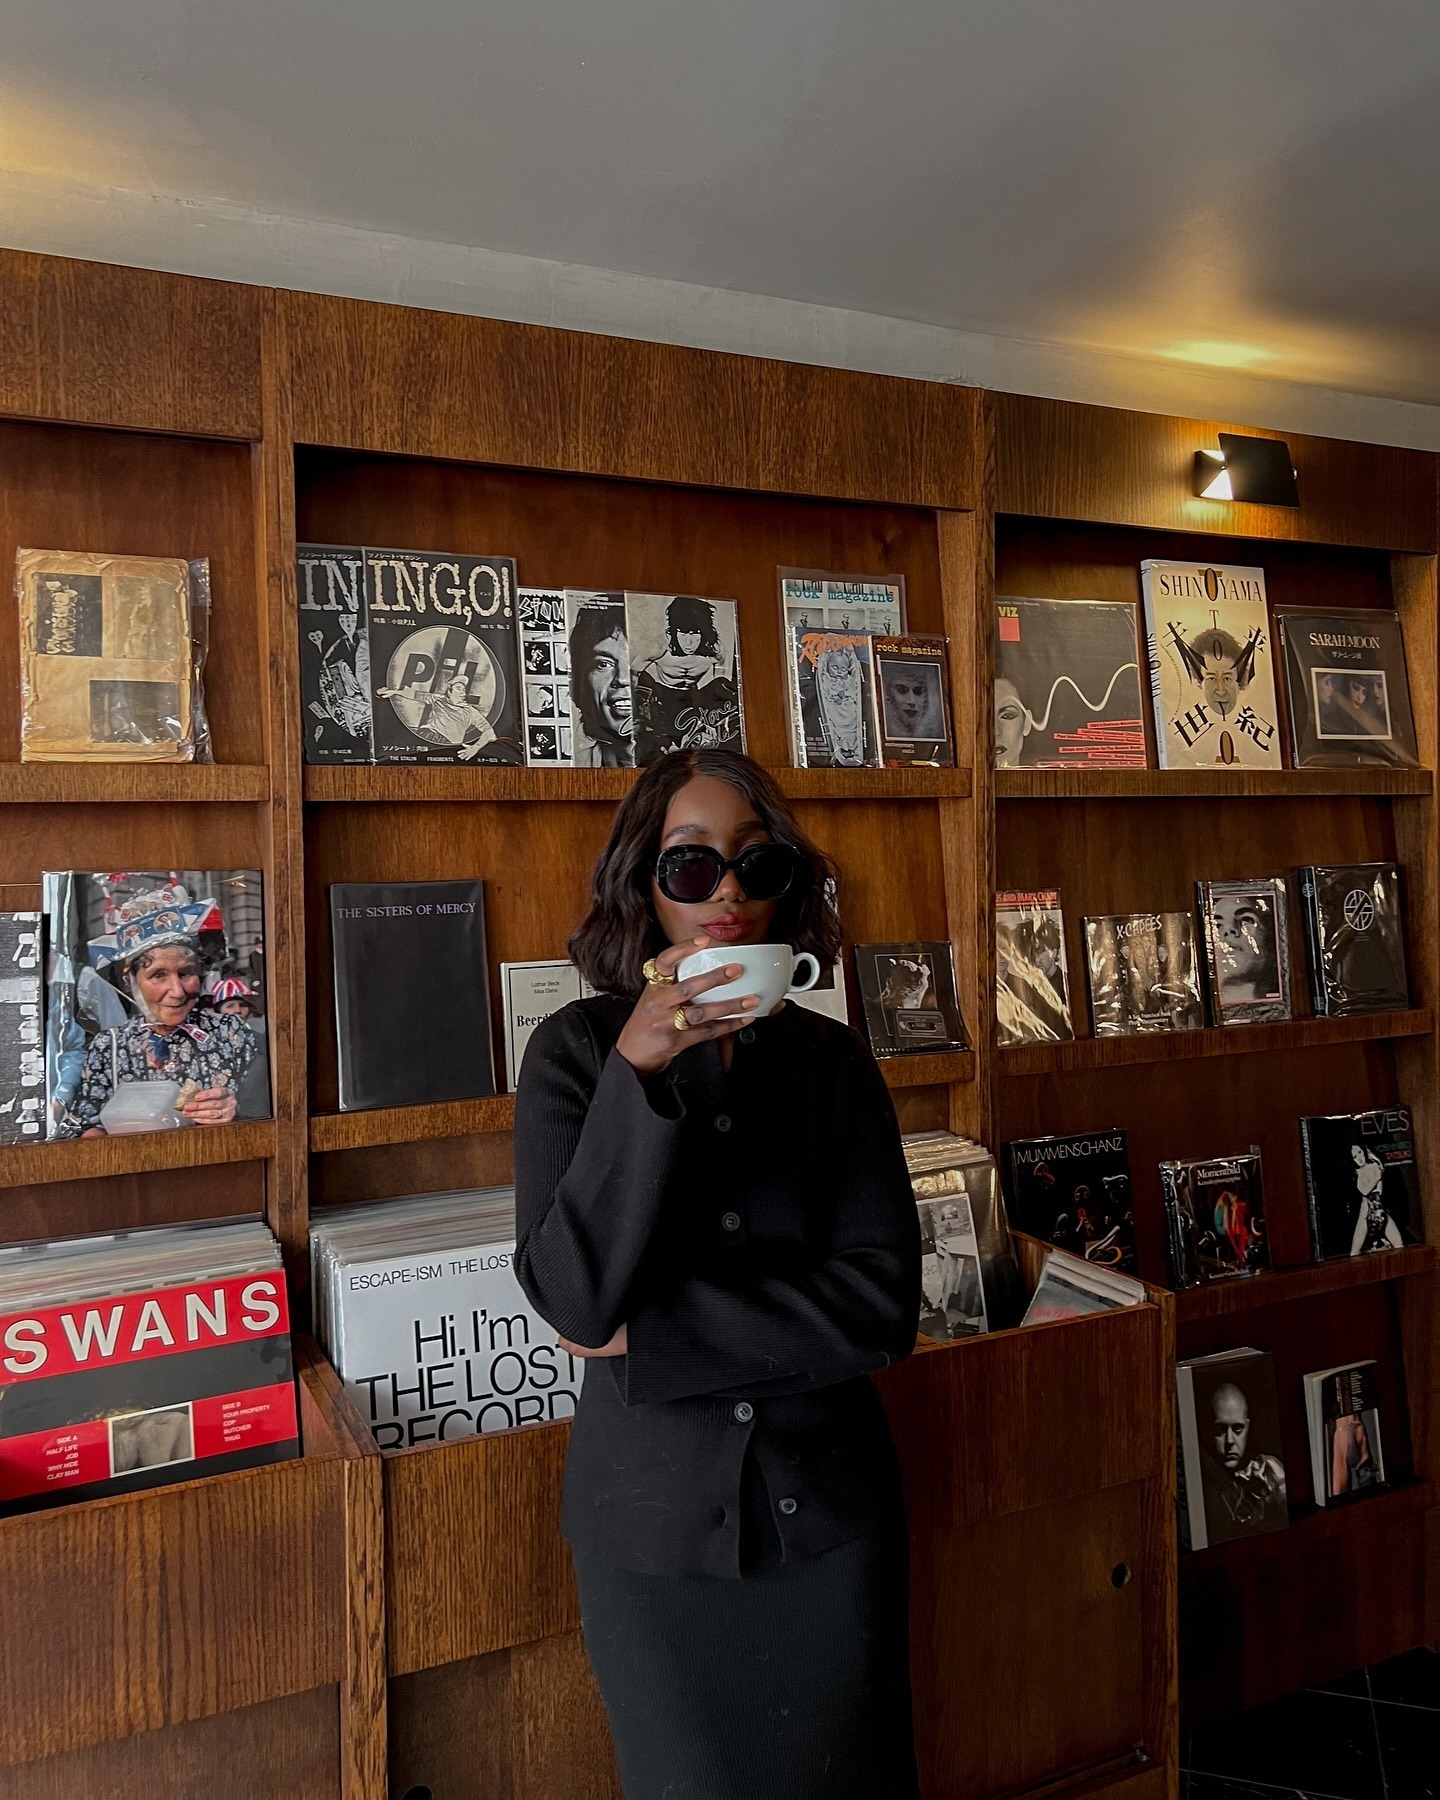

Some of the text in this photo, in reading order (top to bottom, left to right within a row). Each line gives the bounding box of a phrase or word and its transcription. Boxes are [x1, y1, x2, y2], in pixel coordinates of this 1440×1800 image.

[1160, 568, 1263, 602] SHINOYAMA
[786, 586, 894, 604] rock magazine
[998, 606, 1019, 618] VIZ
[1309, 632, 1381, 649] SARAH MOON
[876, 643, 942, 657] rock magazine
[1003, 892, 1017, 902] AND
[337, 902, 477, 919] THE SISTERS OF MERCY
[1361, 1110, 1410, 1135] EVES
[1017, 1136, 1123, 1164] MUMMENSCHANZ
[350, 1264, 442, 1291] ESCAPE-ISM
[449, 1257, 478, 1275] THE
[2, 1280, 281, 1375] SWANS
[414, 1308, 530, 1363] Hi. I'm
[355, 1362, 457, 1421] THE
[223, 1404, 271, 1419] YOUR PROPERTY
[223, 1419, 237, 1427] COP
[223, 1423, 252, 1435] BUTCHER
